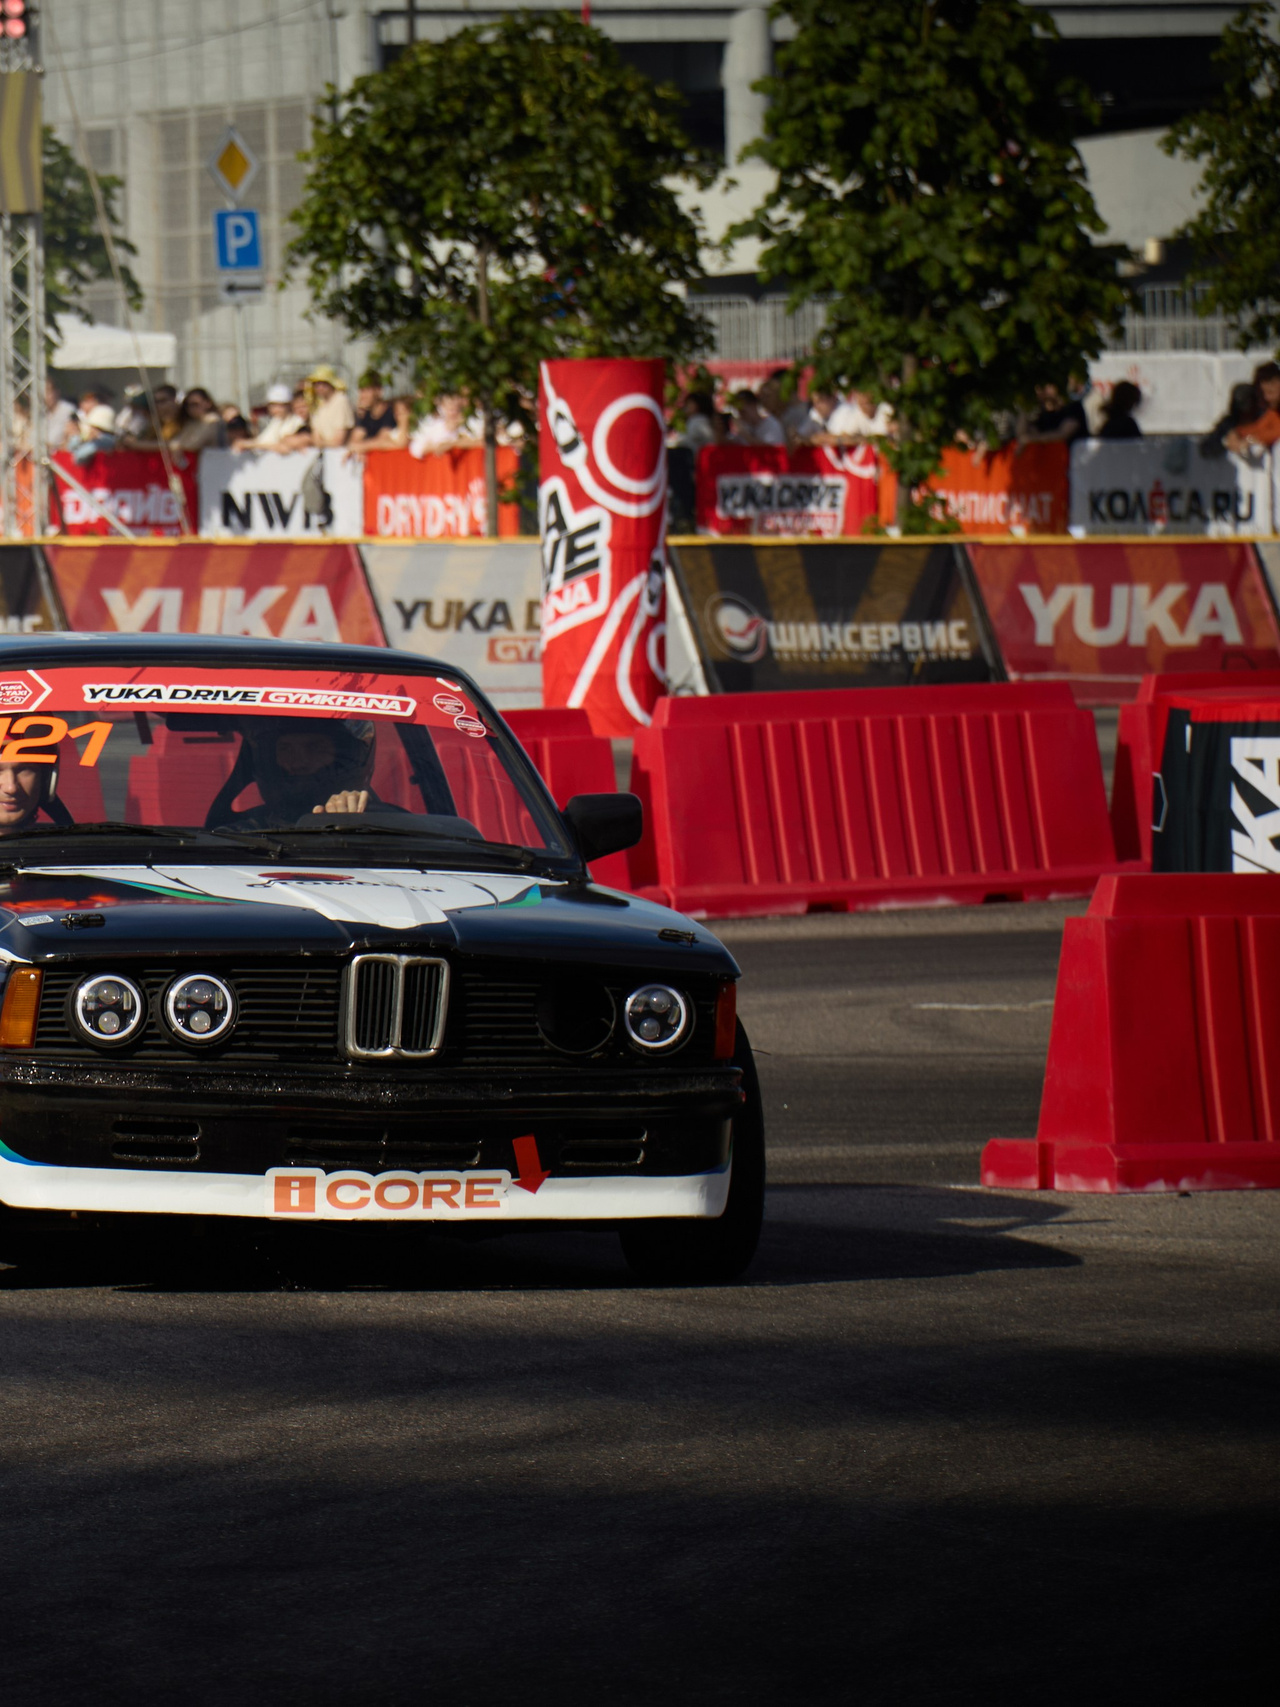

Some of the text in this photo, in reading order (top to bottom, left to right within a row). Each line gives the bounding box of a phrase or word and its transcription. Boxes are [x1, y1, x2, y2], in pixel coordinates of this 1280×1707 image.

[226, 216, 254, 266] P
[100, 584, 343, 643] YUKA
[394, 598, 513, 632] YUKA
[1018, 582, 1244, 647] YUKA
[767, 618, 970, 653] ШИНСЕРВИС
[86, 687, 402, 712] YUKA DRIVE GYMKHANA
